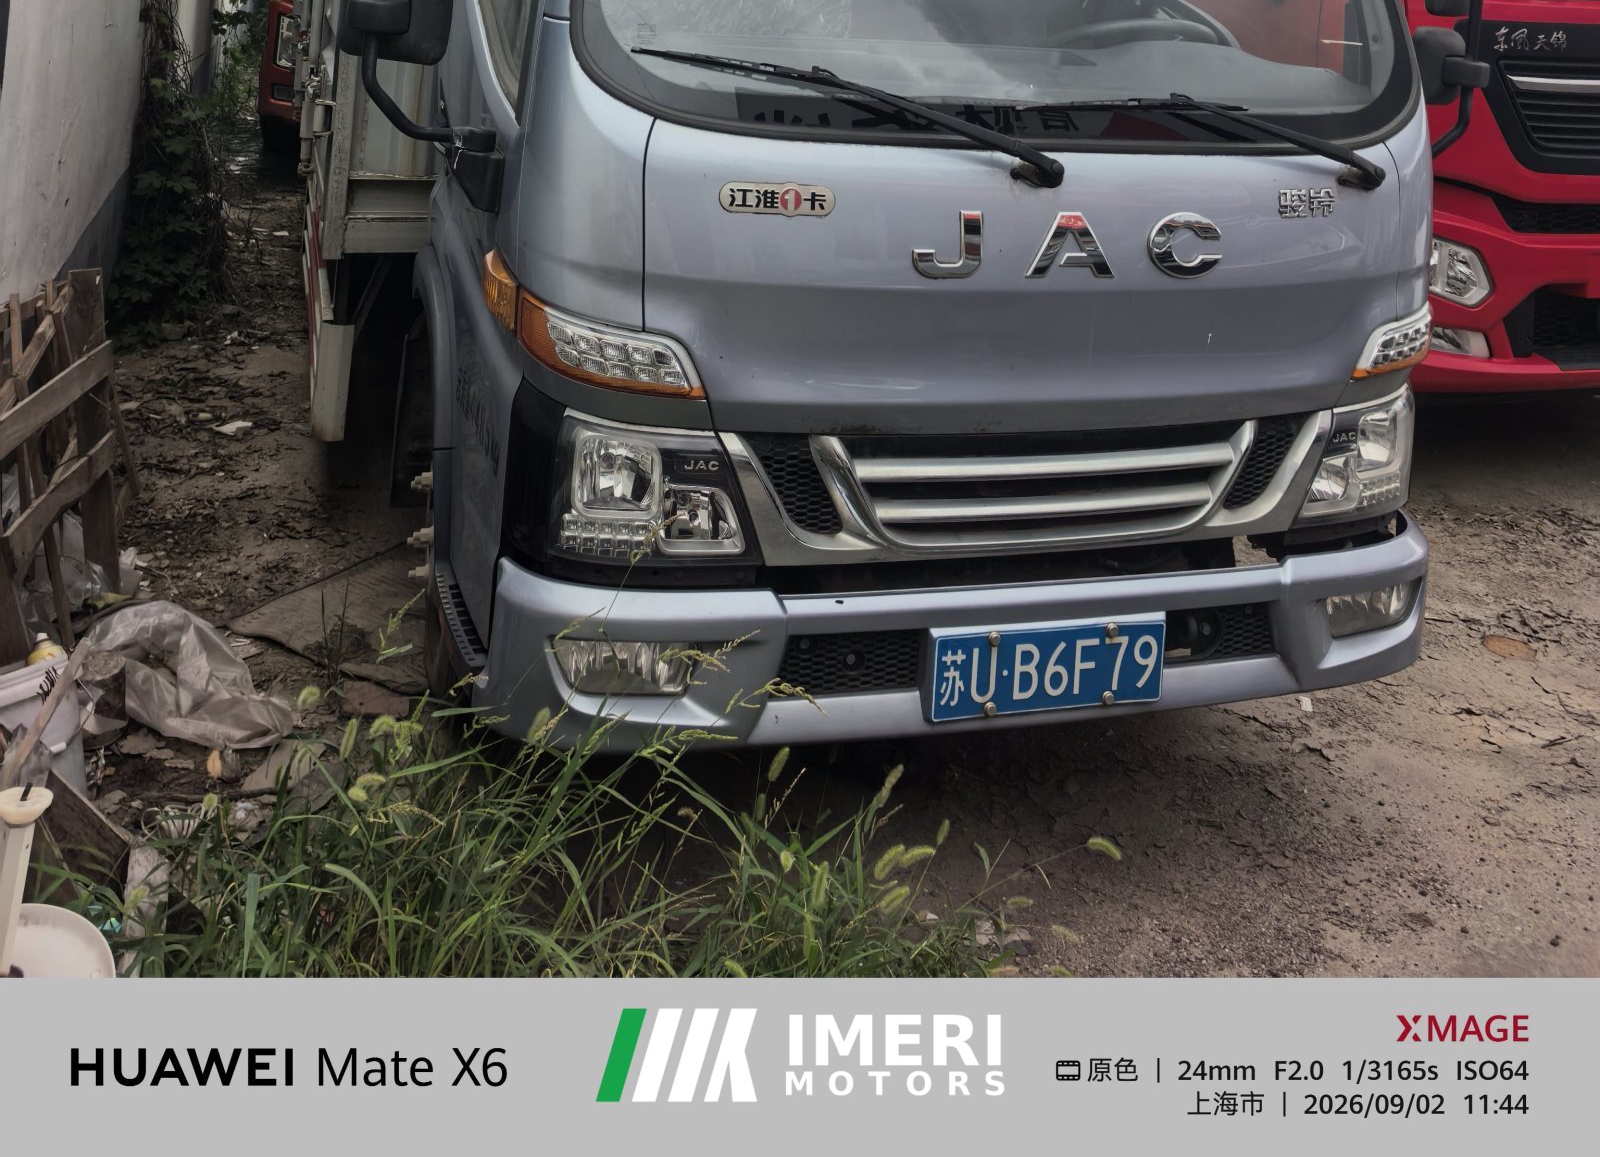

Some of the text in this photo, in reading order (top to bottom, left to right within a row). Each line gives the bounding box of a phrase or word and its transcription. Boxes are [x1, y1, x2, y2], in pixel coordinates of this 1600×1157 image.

[1493, 26, 1567, 52] 东风天锦
[1279, 188, 1335, 218] 骏铃
[911, 210, 1223, 279] JAC
[1332, 431, 1357, 443] JAC
[684, 460, 719, 471] JAC
